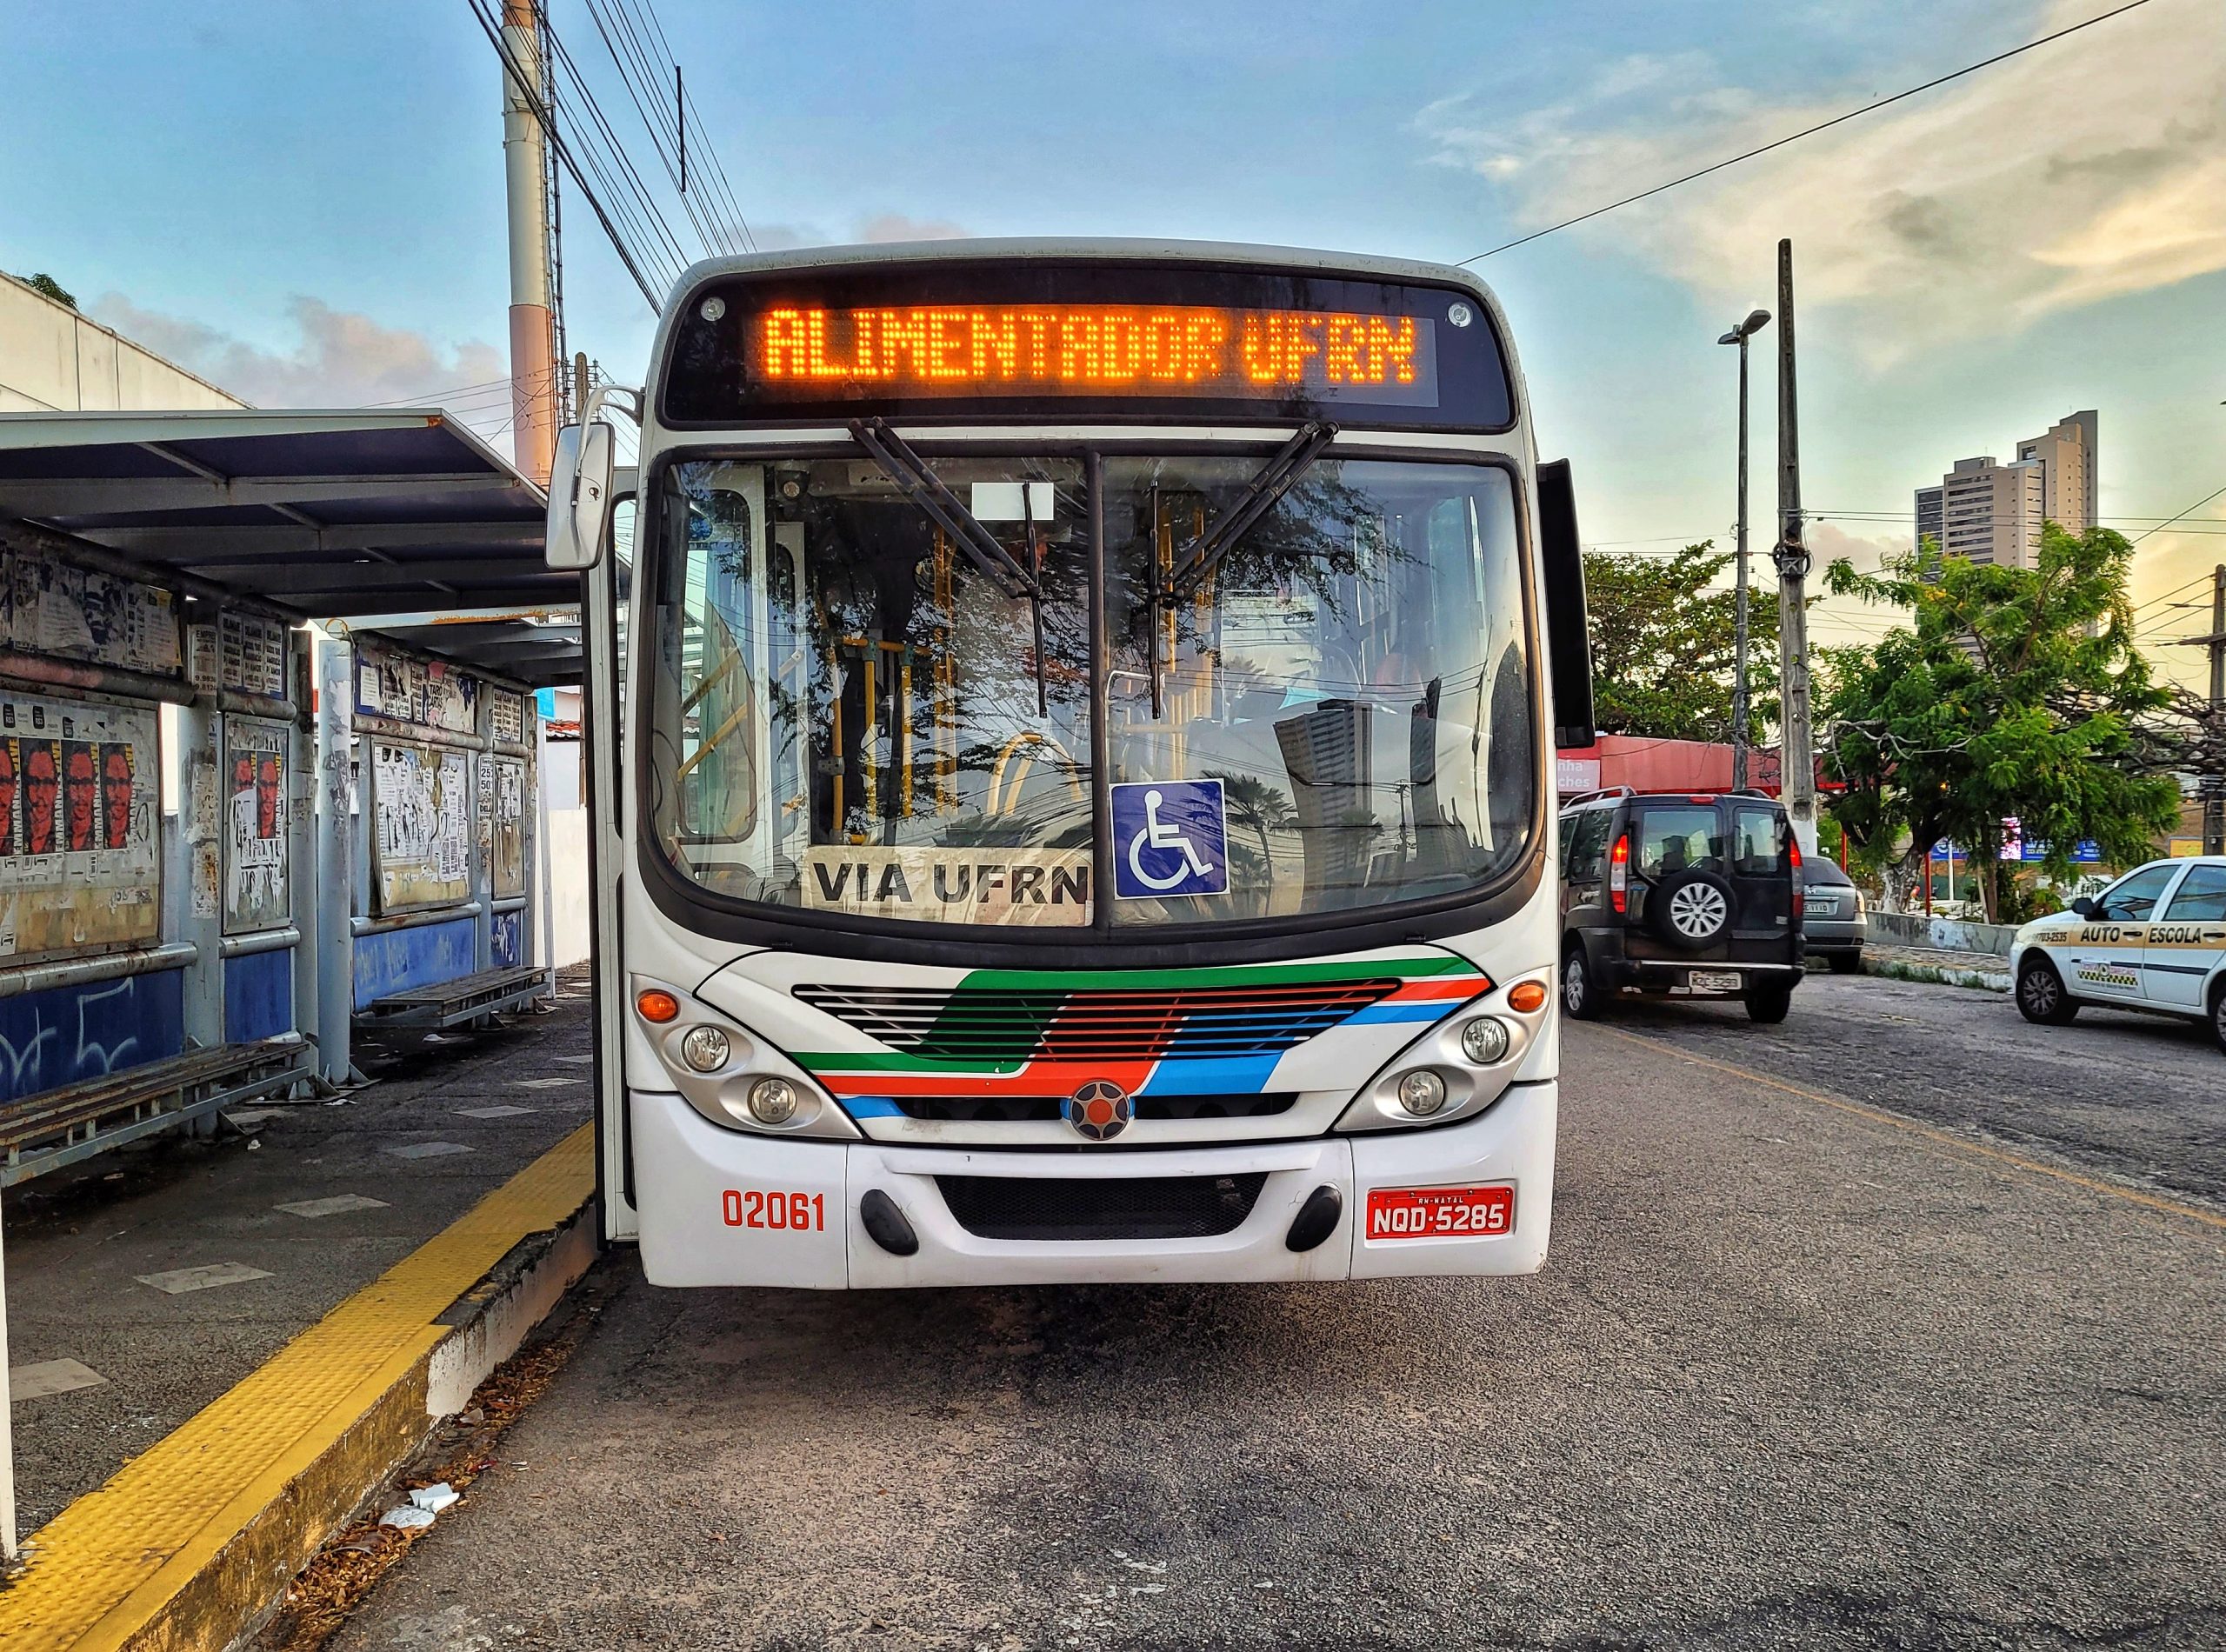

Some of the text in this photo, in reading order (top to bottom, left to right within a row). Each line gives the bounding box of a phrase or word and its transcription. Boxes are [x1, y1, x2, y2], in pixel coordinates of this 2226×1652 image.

[764, 309, 1416, 383] ALIMENTADOR UFRN
[812, 862, 1090, 906] VIA UFRN
[2080, 927, 2202, 944] AUTO ESCOLA
[721, 1189, 825, 1233] 02061
